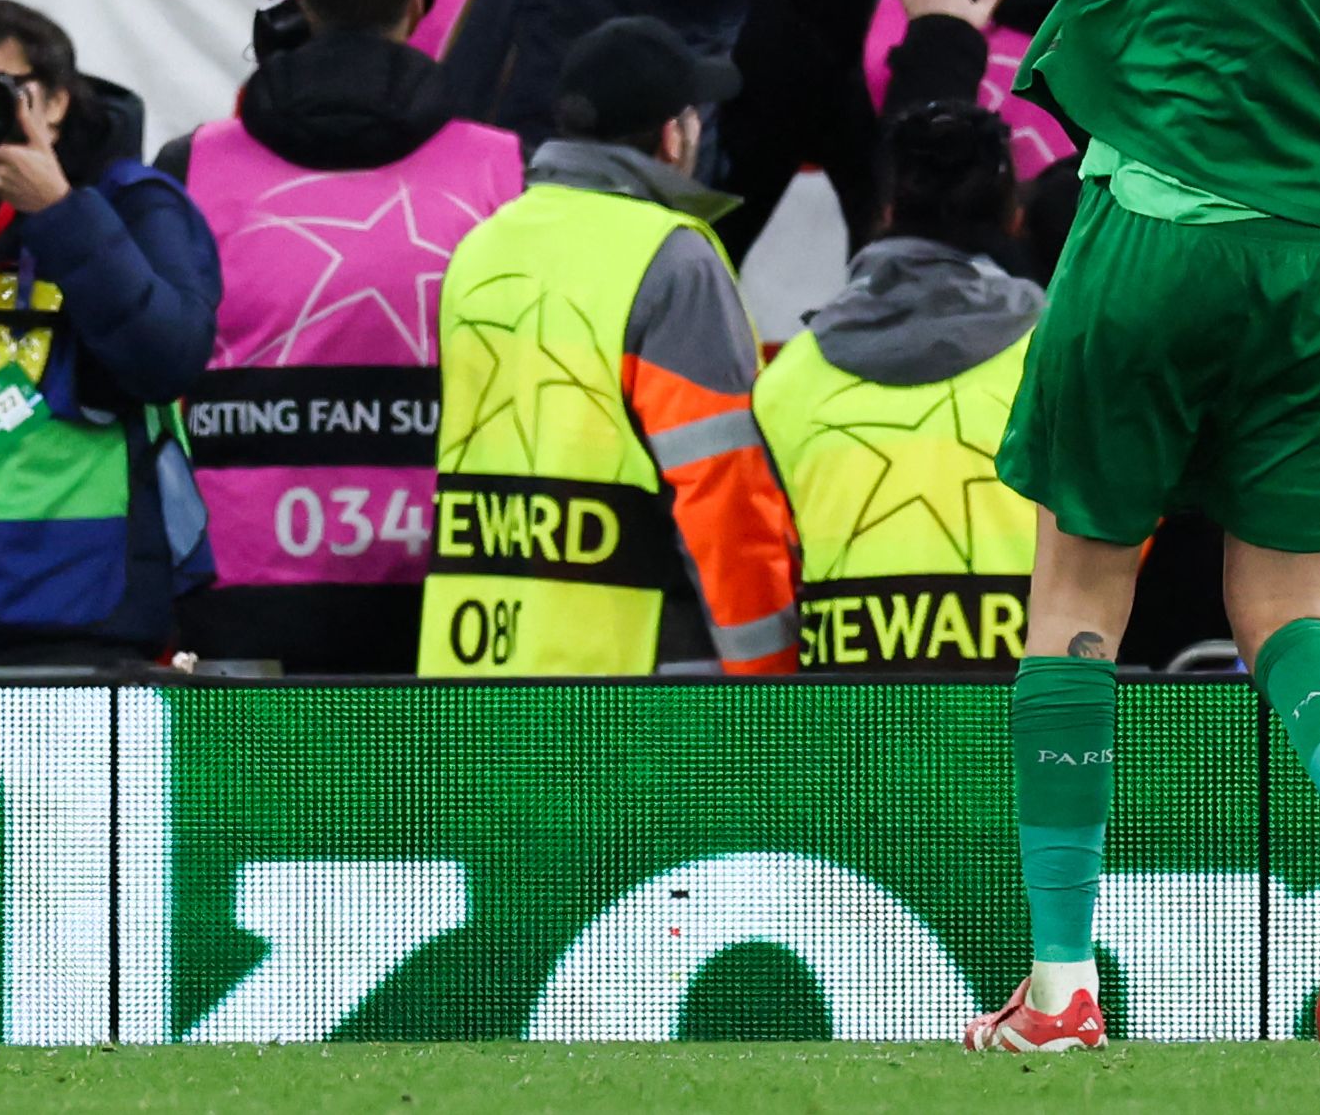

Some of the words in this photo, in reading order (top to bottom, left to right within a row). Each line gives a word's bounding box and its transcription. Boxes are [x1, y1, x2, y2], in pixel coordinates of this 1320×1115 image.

[308, 399, 381, 433] FAN
[274, 486, 433, 558] 034
[432, 490, 621, 566] EWARD
[1036, 747, 1116, 766] PARIS
